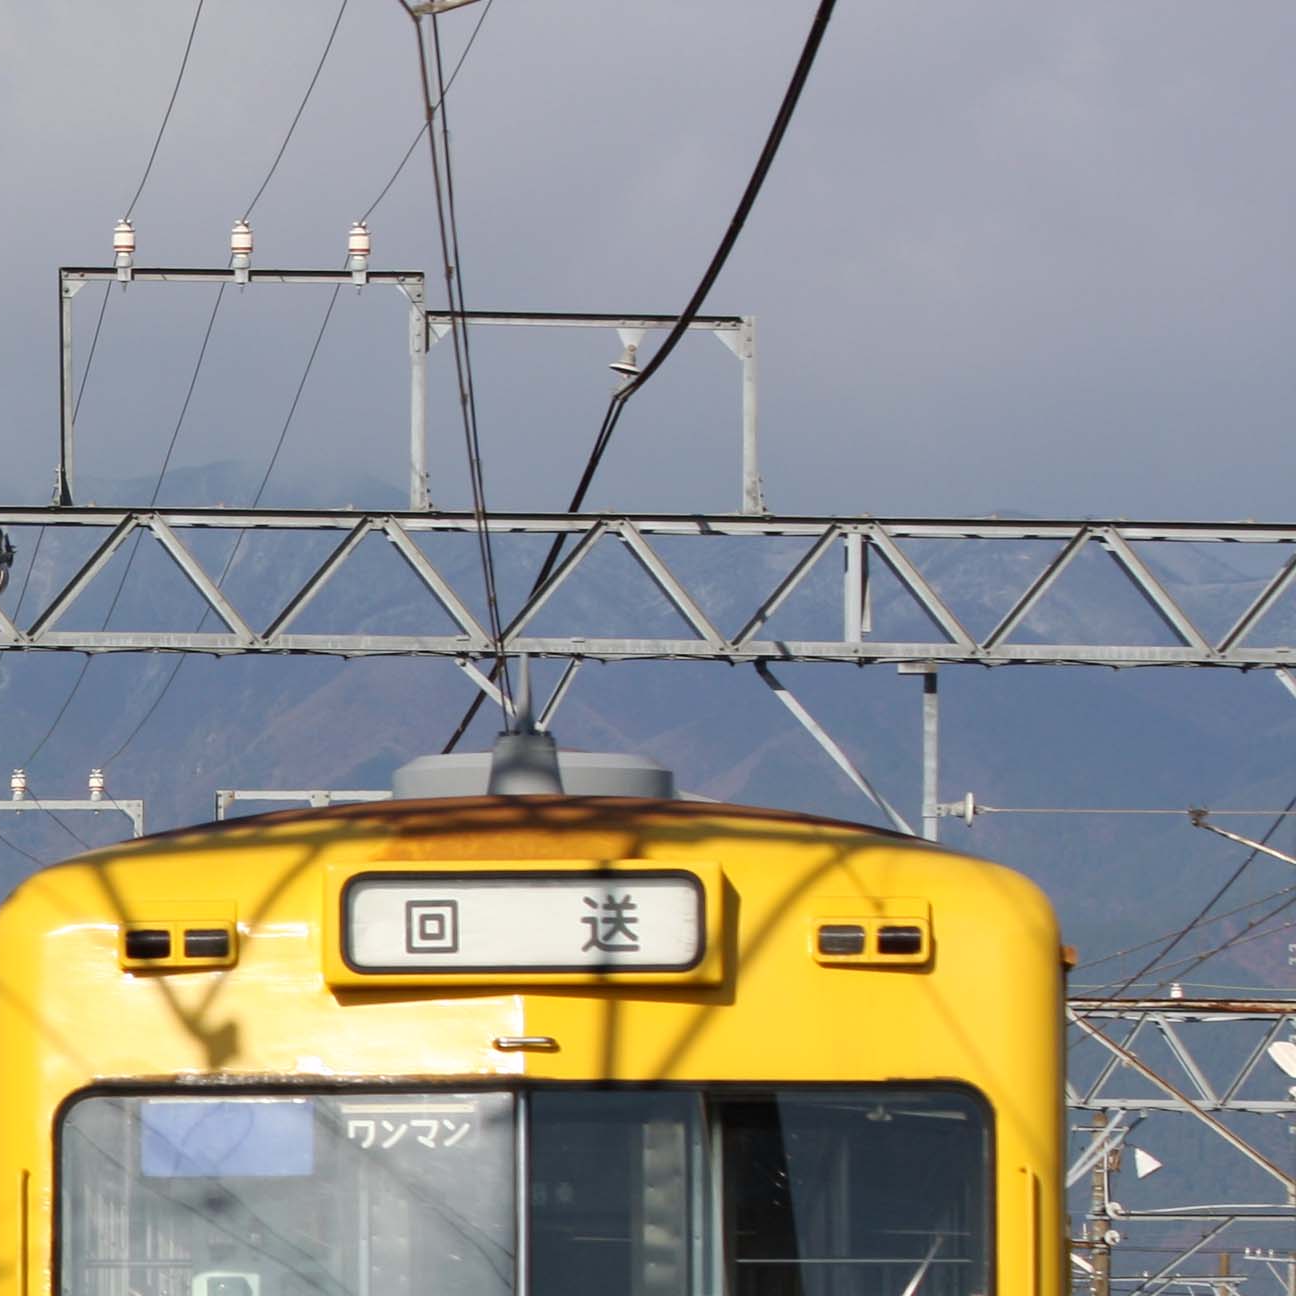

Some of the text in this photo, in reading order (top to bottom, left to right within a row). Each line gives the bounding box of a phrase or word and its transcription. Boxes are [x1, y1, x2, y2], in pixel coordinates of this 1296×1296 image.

[405, 894, 640, 954] 回送
[348, 1119, 471, 1149] ワンマン
